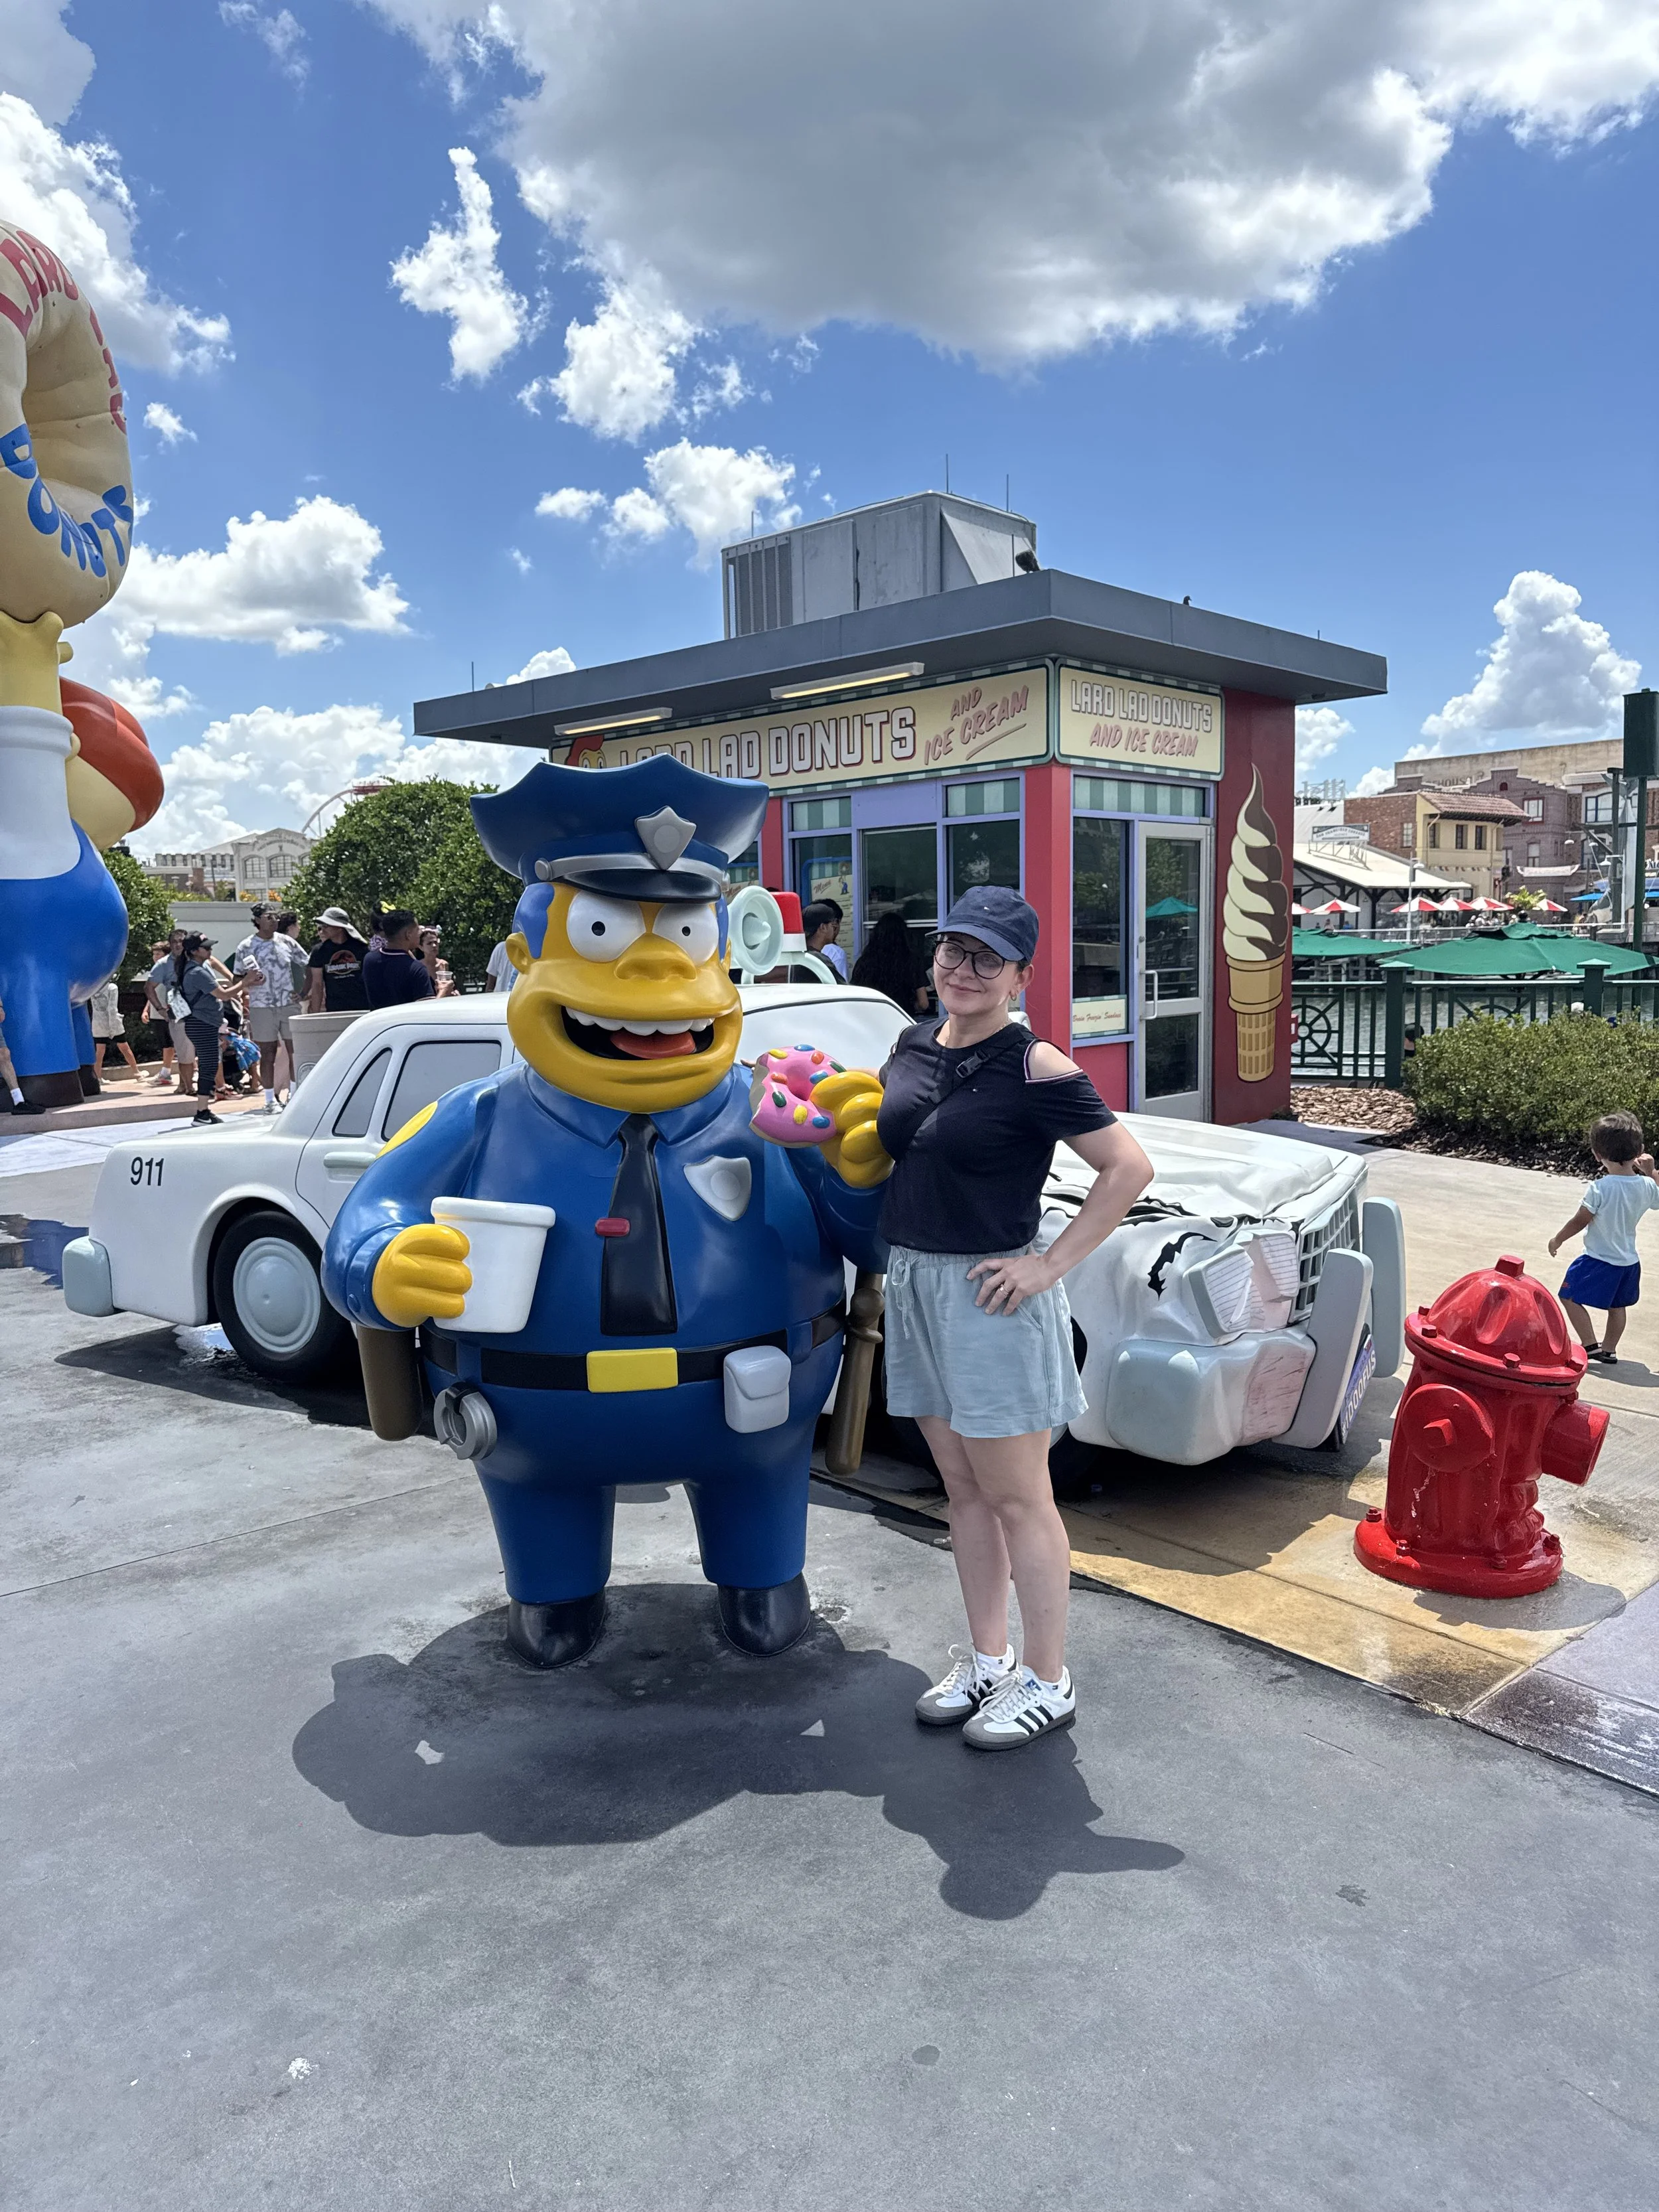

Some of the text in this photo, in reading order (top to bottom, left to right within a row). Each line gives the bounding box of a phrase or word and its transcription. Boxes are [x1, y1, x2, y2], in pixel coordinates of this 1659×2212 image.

[924, 685, 1029, 765] ICE CREAM
[950, 686, 982, 721] AND
[1071, 680, 1212, 733] LARD LAD DONUTS
[702, 729, 762, 779] LAD
[768, 706, 916, 777] DONUTS
[1089, 722, 1198, 757] AND ICE CREAM
[130, 1156, 165, 1187] 911
